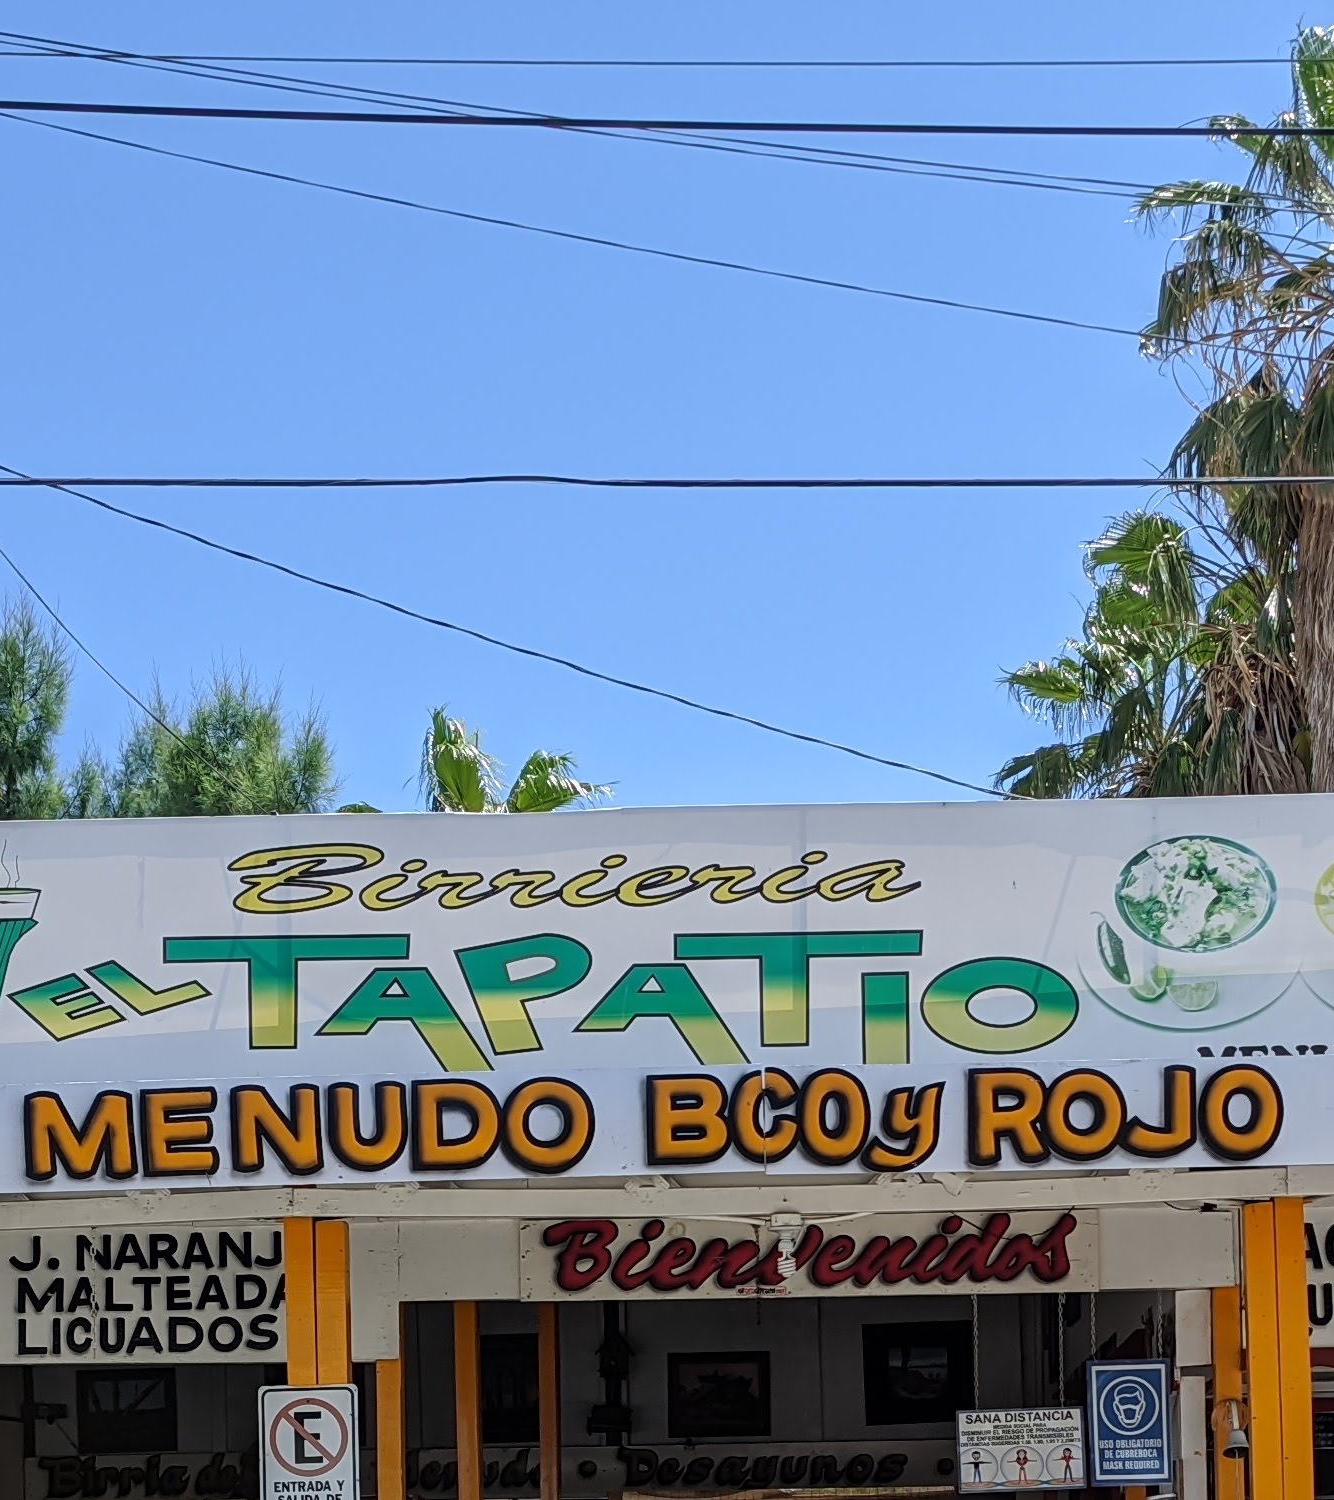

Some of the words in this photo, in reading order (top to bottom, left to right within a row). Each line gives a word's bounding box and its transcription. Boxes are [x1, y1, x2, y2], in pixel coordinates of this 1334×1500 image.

[228, 843, 921, 914] Birrieria
[7, 960, 212, 1041] EL
[163, 930, 1079, 1071] TAPATIO
[24, 1077, 595, 1183] MENUDO
[646, 1064, 868, 1167] BCO
[865, 1080, 945, 1172] y
[967, 1063, 1283, 1167] ROJO
[10, 1236, 59, 1272] J.
[76, 1230, 282, 1272] NARANJ
[543, 1211, 1078, 1292] Bienvenidos
[17, 1273, 285, 1315] MALTEAD
[18, 1313, 279, 1357] LICUADOS
[293, 1411, 323, 1464] E
[965, 1413, 1001, 1425] SANA
[1005, 1410, 1074, 1423] DISTANCIA
[976, 1434, 1025, 1442] ENFERMEDADES
[1027, 1432, 1074, 1440] TRANSMISIBLES
[1099, 1440, 1114, 1449] USO
[1115, 1438, 1162, 1448] OBLIGATORIO
[1102, 1460, 1123, 1470] MASK
[1124, 1459, 1160, 1469] REQUIRED
[1104, 1450, 1114, 1459] DE
[1115, 1449, 1158, 1458] CUBREBOCA
[38, 1454, 190, 1499] Birria
[618, 1447, 909, 1489] Desayunos
[274, 1480, 331, 1493] ENTRADA
[336, 1480, 345, 1491] Y
